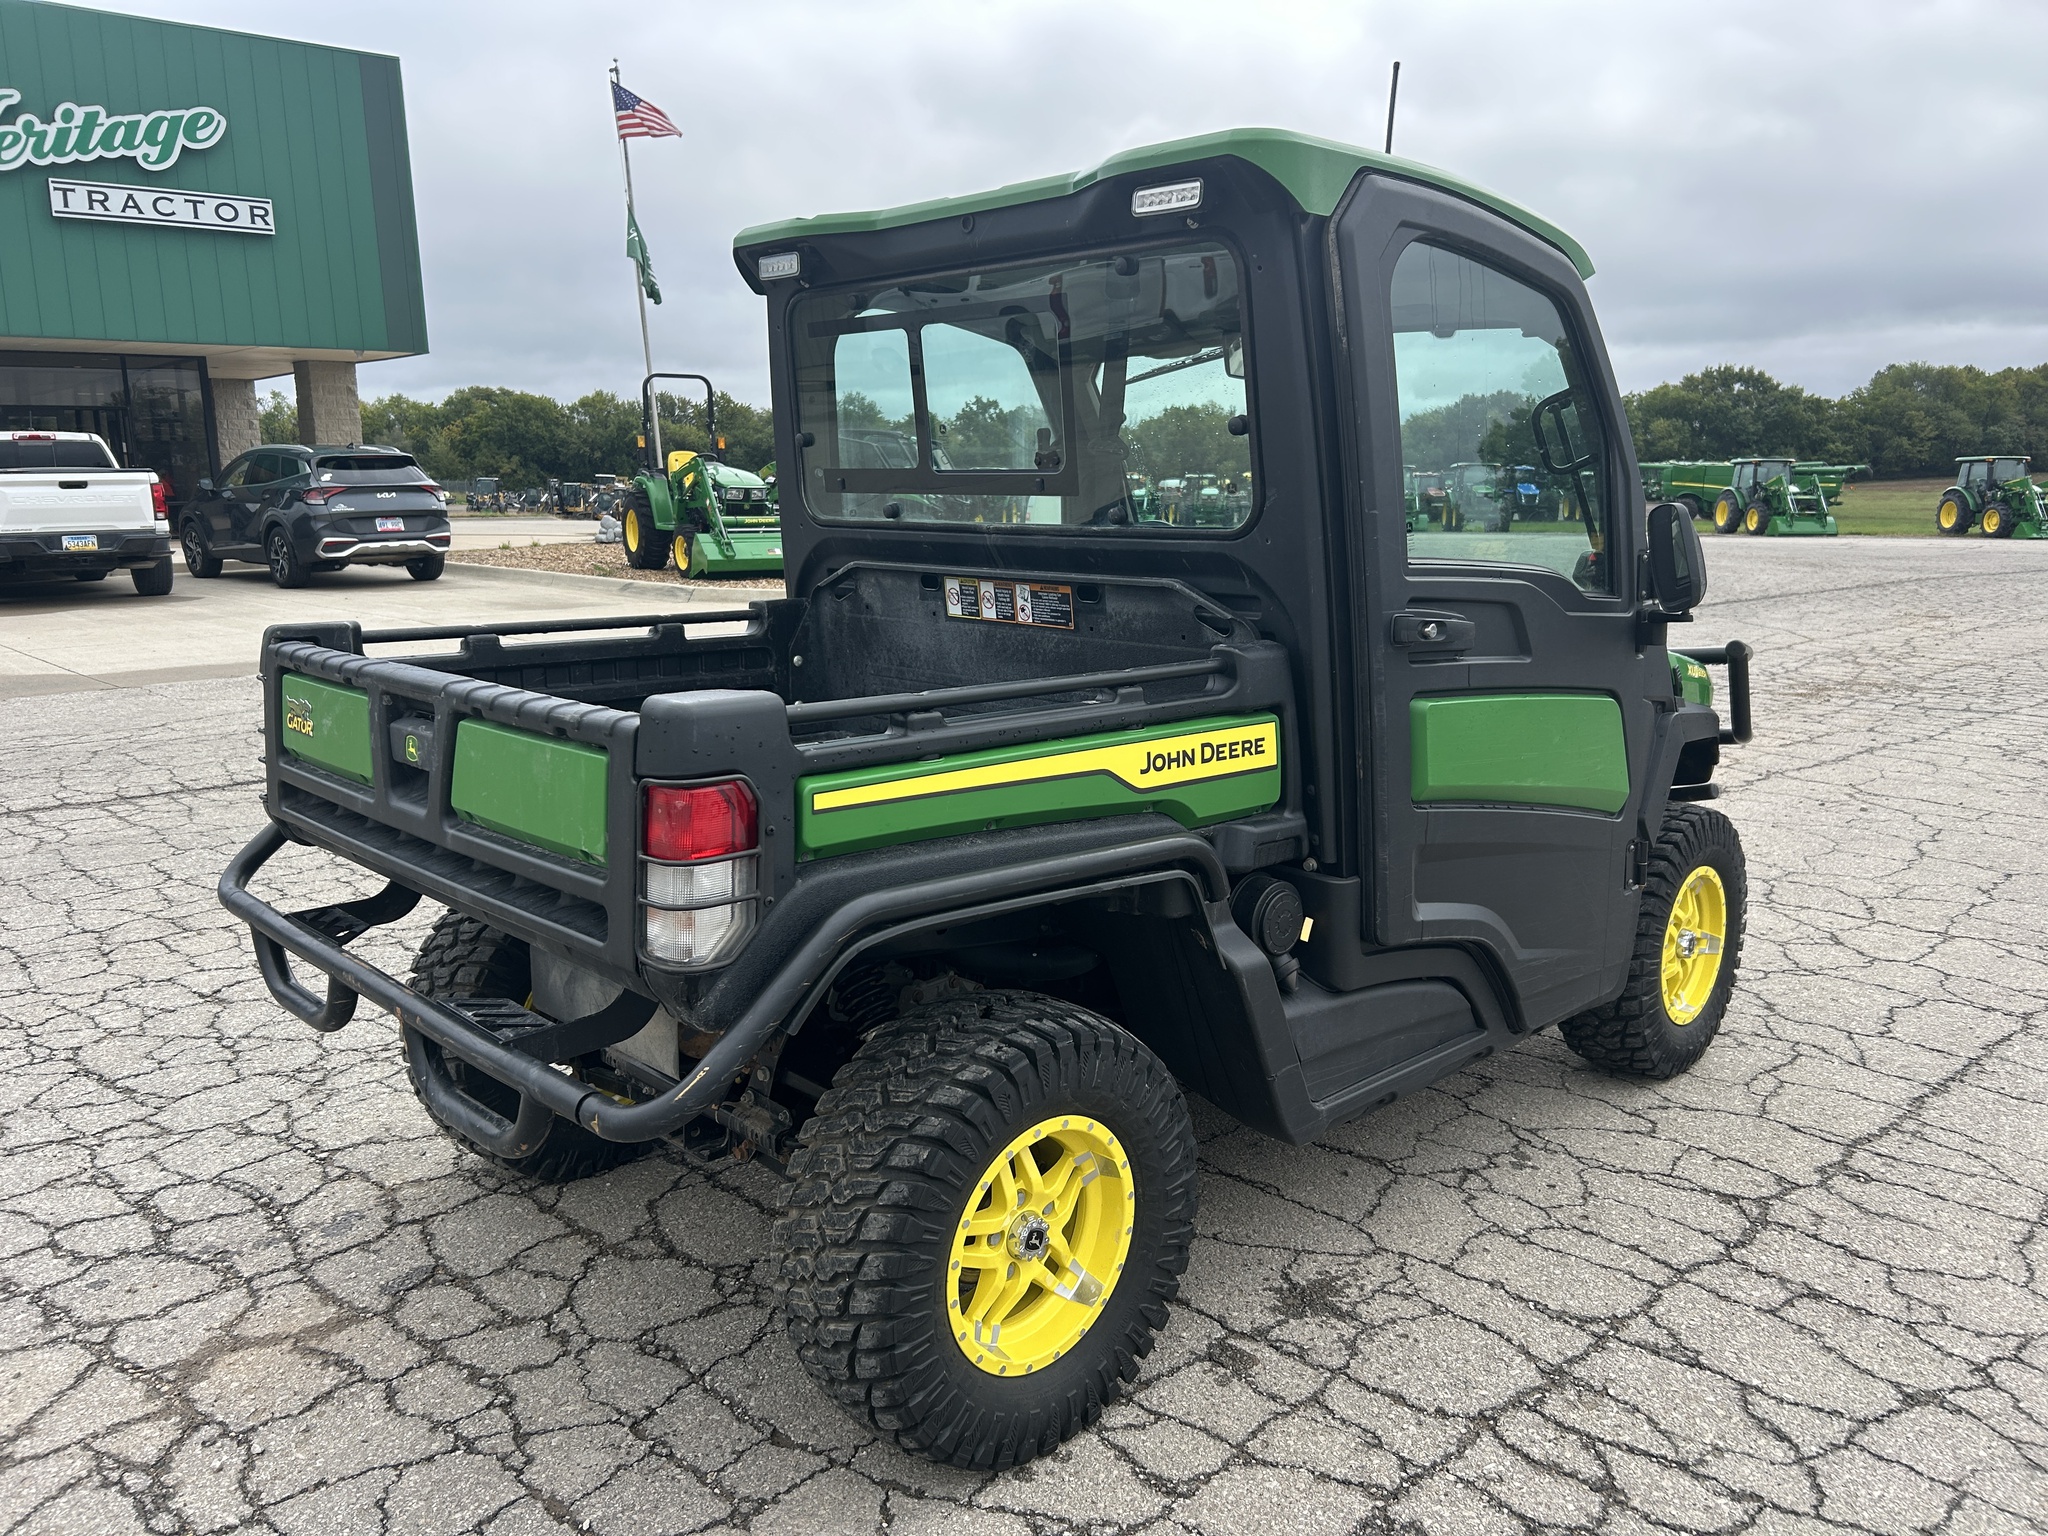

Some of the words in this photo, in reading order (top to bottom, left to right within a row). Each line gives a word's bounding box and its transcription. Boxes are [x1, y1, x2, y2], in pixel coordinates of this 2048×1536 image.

[0, 89, 226, 170] eritage
[53, 186, 271, 227] TRACTOR
[11, 494, 137, 505] CHEVROLET
[287, 713, 313, 737] GATOR
[1140, 748, 1195, 775] JOHN
[1200, 737, 1265, 764] DEERE
